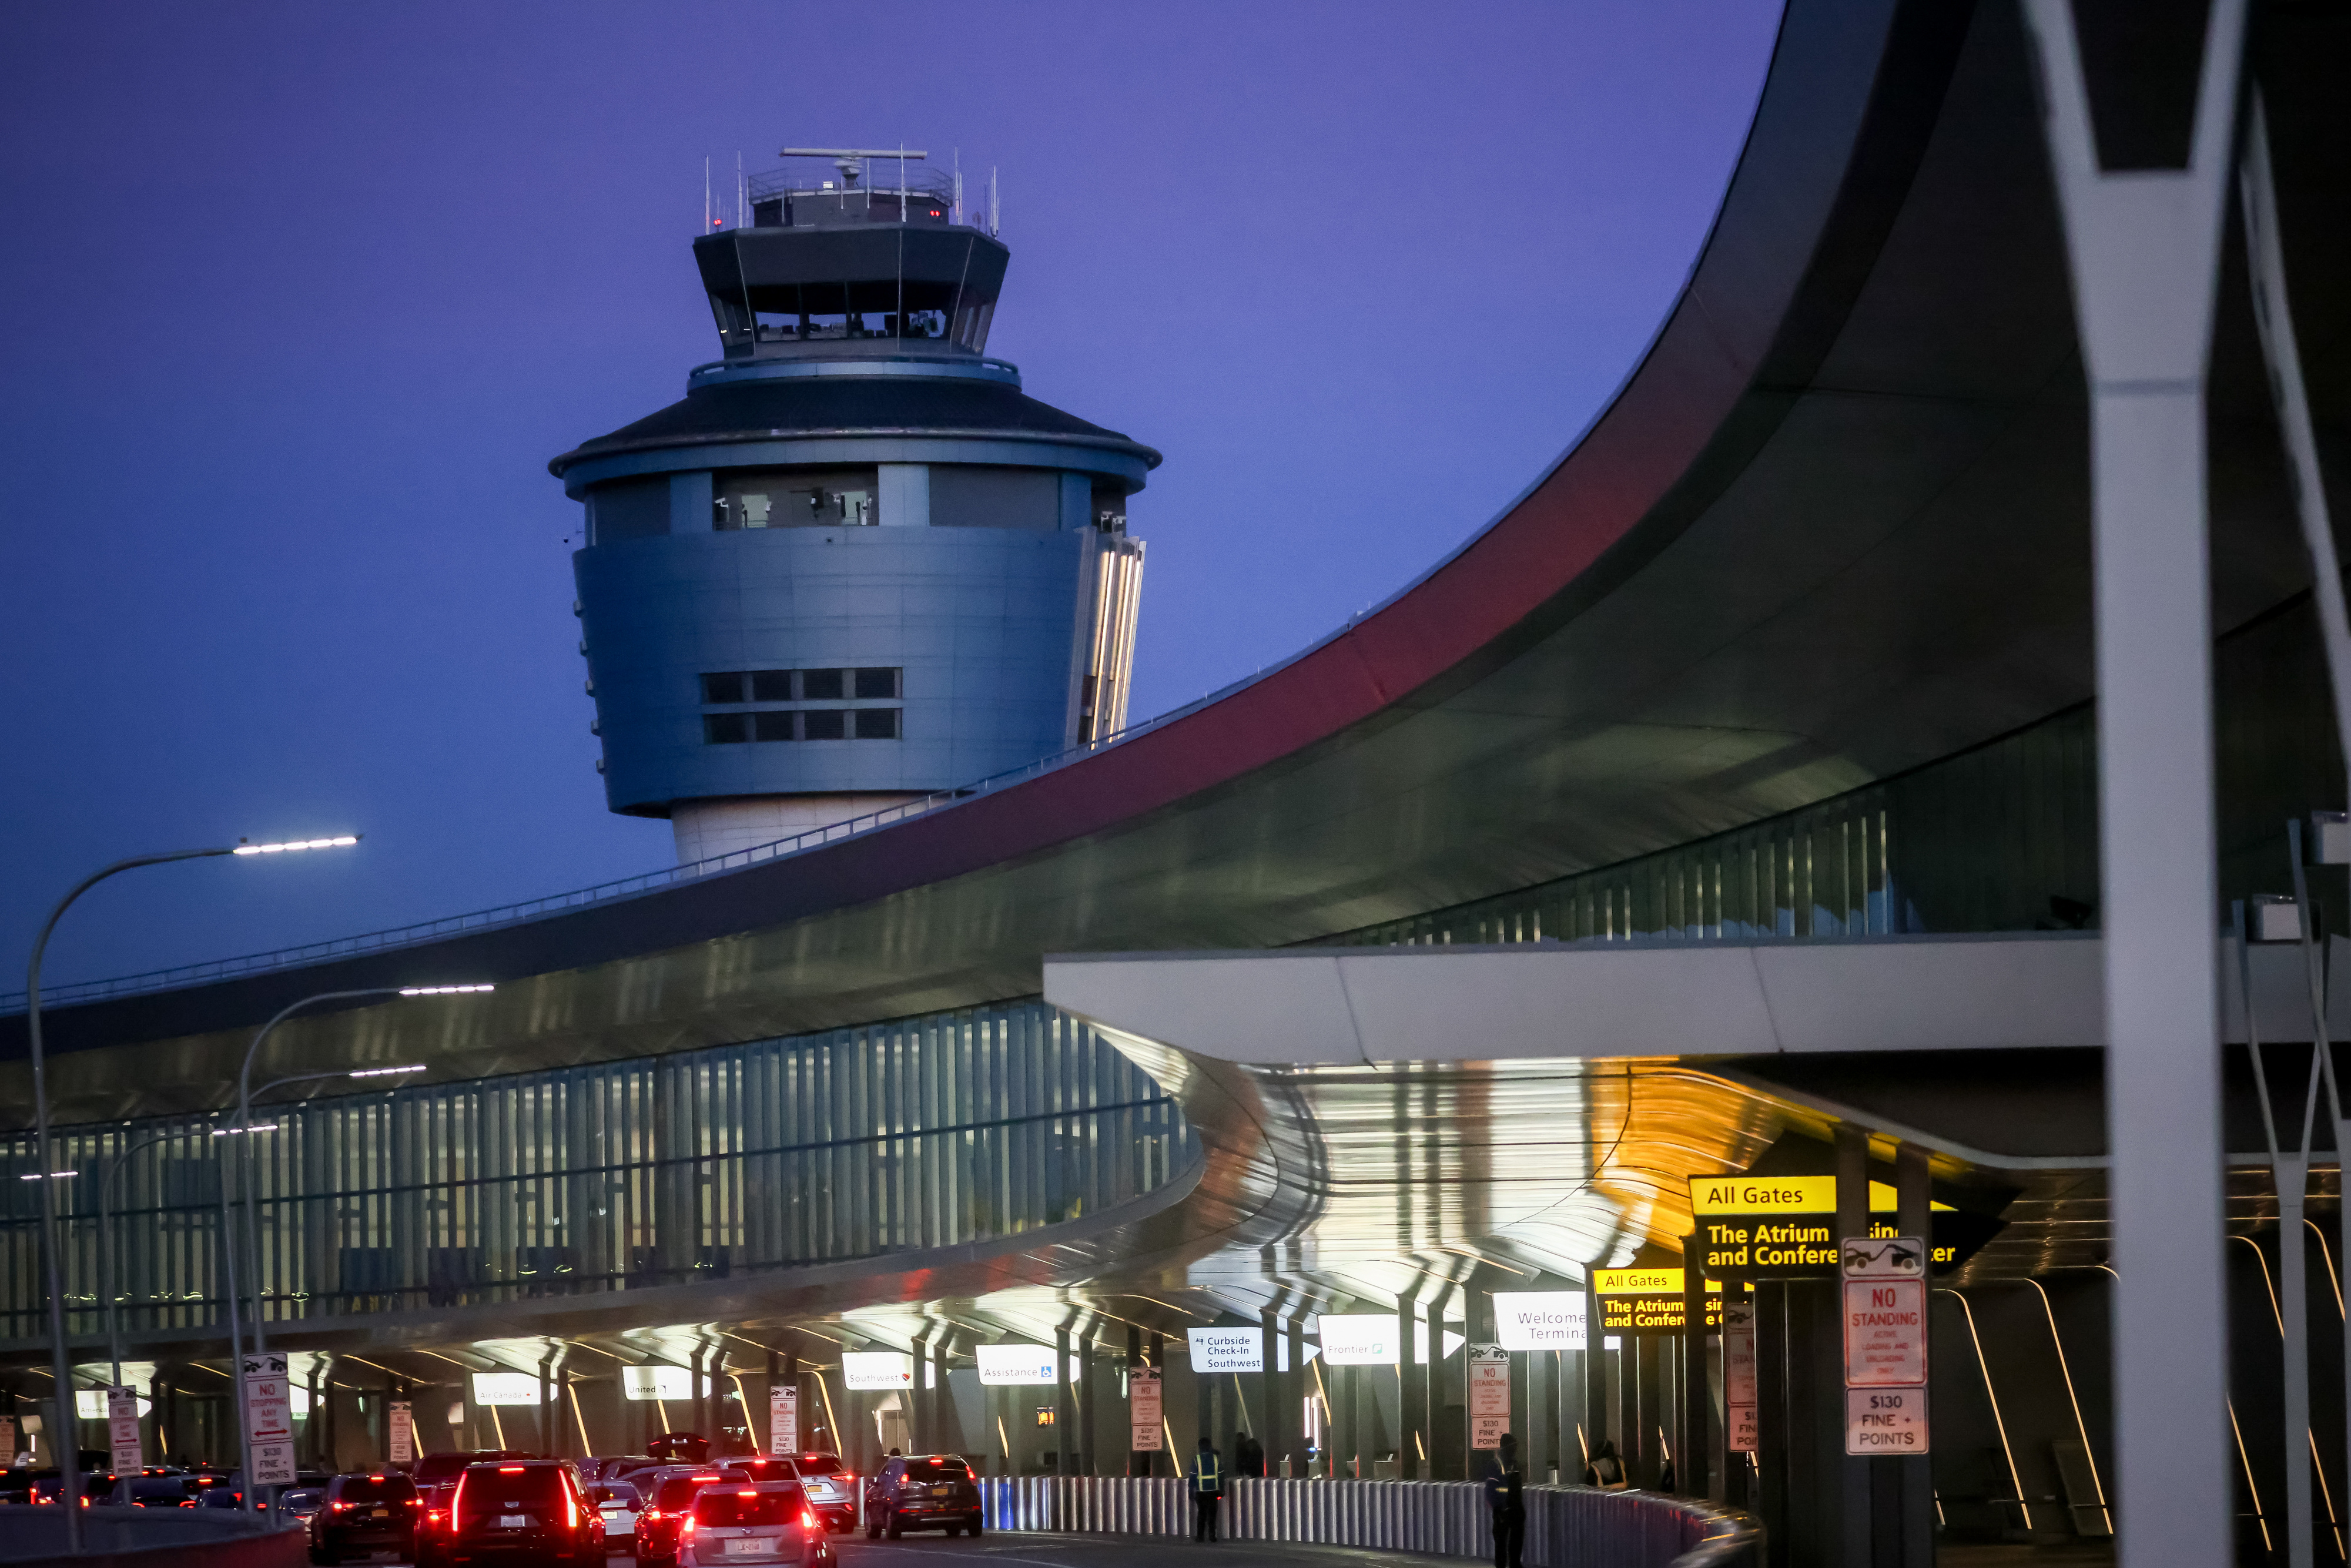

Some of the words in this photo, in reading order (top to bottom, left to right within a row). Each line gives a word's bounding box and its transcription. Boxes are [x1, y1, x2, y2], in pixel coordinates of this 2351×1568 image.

[1707, 1187, 1734, 1204] All
[1744, 1187, 1803, 1204] Gates
[1707, 1224, 1748, 1244] The
[1754, 1224, 1828, 1243] Atrium
[1707, 1246, 1748, 1265] and
[1754, 1244, 1838, 1265] Confere
[1606, 1275, 1623, 1286] All
[1629, 1275, 1667, 1286] Gates
[1873, 1288, 1896, 1308] NO
[1605, 1300, 1631, 1312] The
[1635, 1299, 1684, 1312] Atrium
[1518, 1312, 1586, 1324] Welcome
[1605, 1315, 1632, 1326] and
[1852, 1312, 1918, 1326] STANDING
[1529, 1327, 1586, 1339] Termina
[1208, 1336, 1250, 1345] Curbside
[1208, 1346, 1249, 1355] Check-In
[1329, 1345, 1368, 1353] Frontier
[984, 1368, 1037, 1376] Assistance
[1484, 1368, 1495, 1378] NO
[259, 1383, 275, 1396] NO
[1141, 1386, 1151, 1395] NO
[250, 1398, 286, 1407] STOPPING
[1870, 1396, 1903, 1409] $130
[1862, 1414, 1895, 1426] FINE
[1739, 1425, 1756, 1433] FIN
[1860, 1432, 1914, 1445] POINTS
[259, 1459, 279, 1468] FINE
[258, 1470, 289, 1479] POINTS
